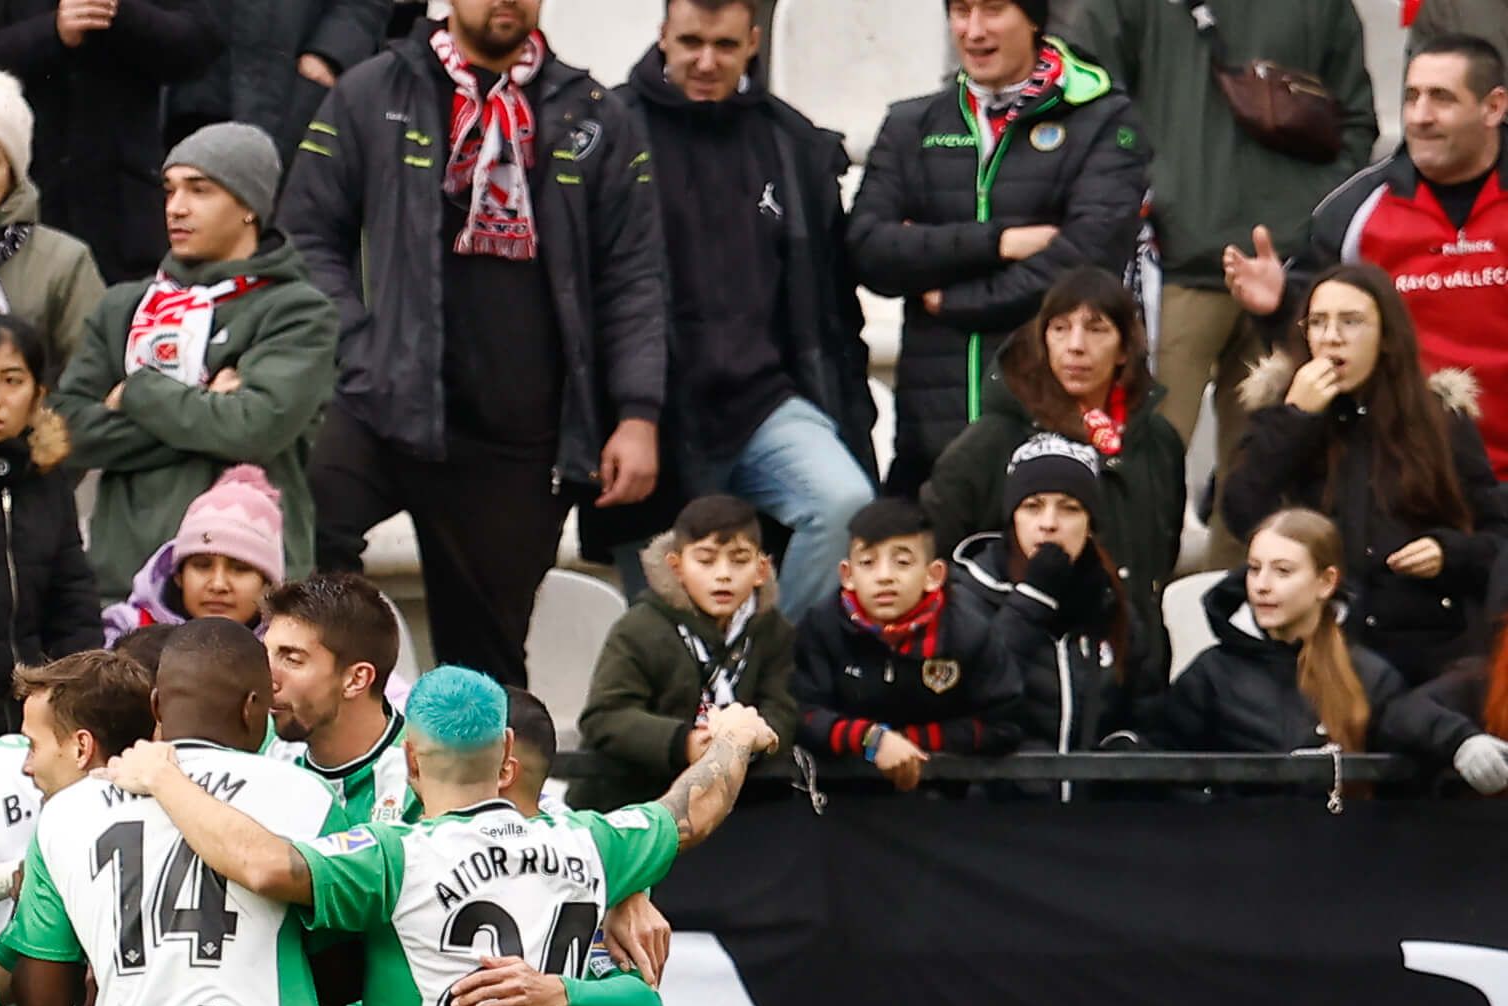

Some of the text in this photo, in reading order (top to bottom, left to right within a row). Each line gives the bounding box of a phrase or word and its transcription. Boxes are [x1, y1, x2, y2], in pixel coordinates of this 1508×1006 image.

[1395, 273, 1443, 293] RAYO
[89, 820, 238, 977] 14
[434, 846, 509, 911] AITOR
